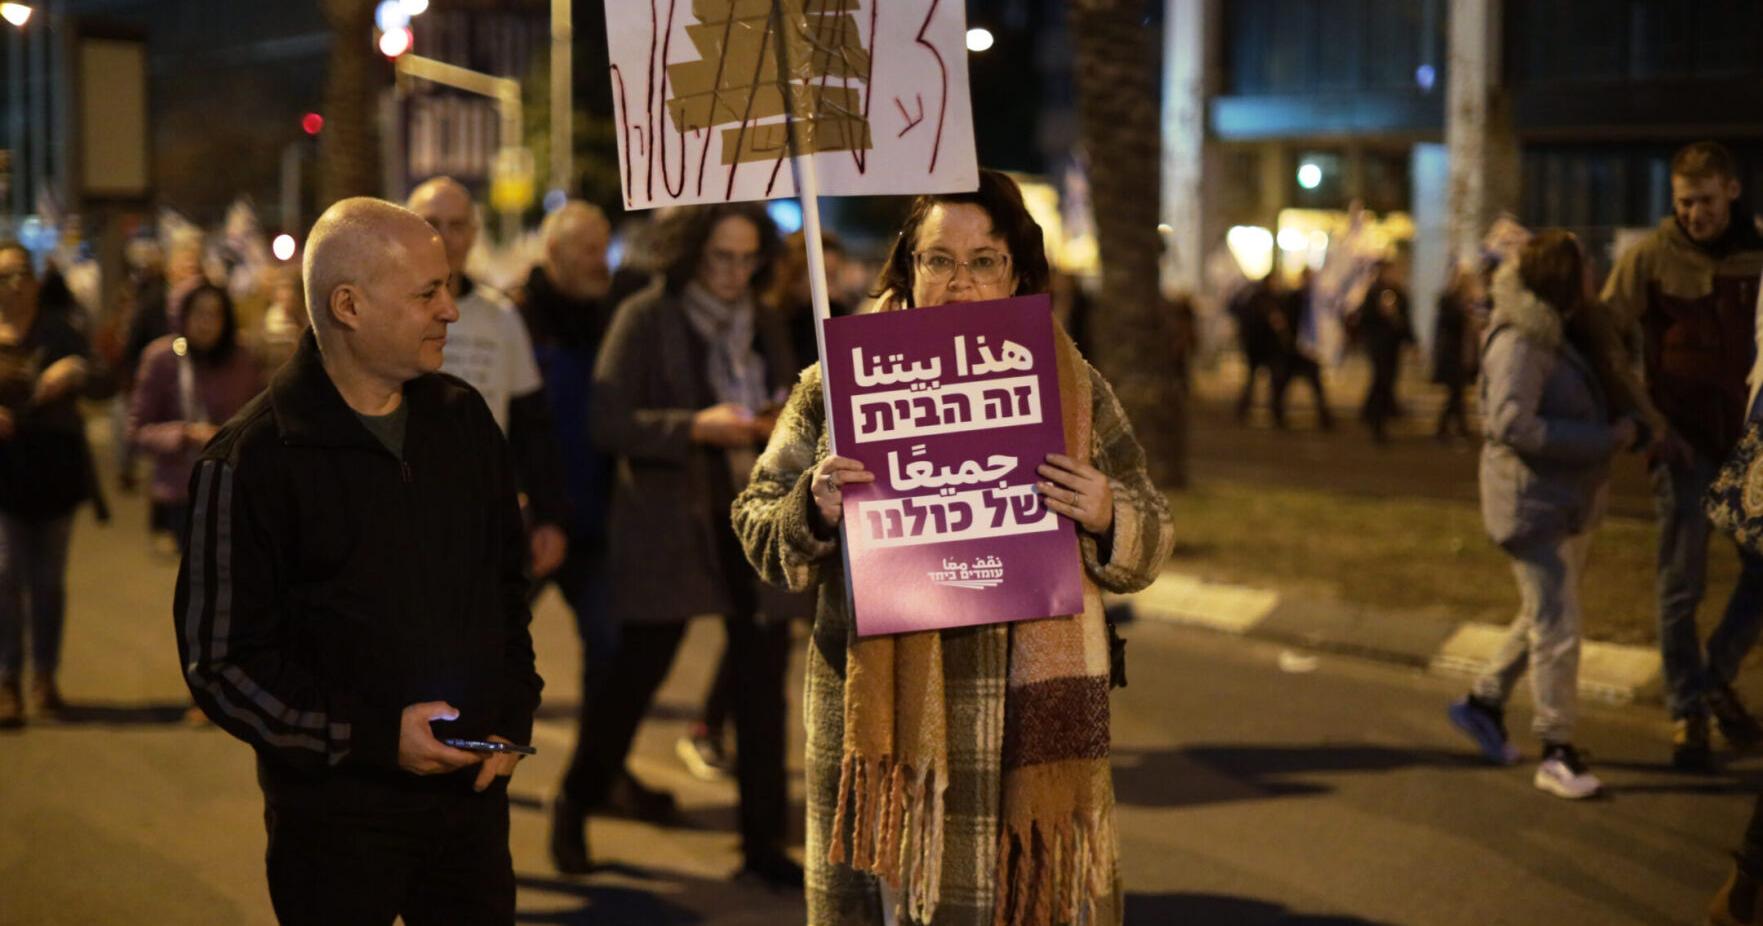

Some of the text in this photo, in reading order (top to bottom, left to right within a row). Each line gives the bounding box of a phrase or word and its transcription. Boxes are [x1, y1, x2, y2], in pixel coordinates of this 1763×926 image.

[851, 334, 1034, 392] هذا بيتنا
[861, 385, 1032, 434] זה הבית
[887, 444, 1019, 497] جميعًا
[866, 489, 1048, 540] של כולנו
[927, 568, 1003, 581] עומדים ביחד
